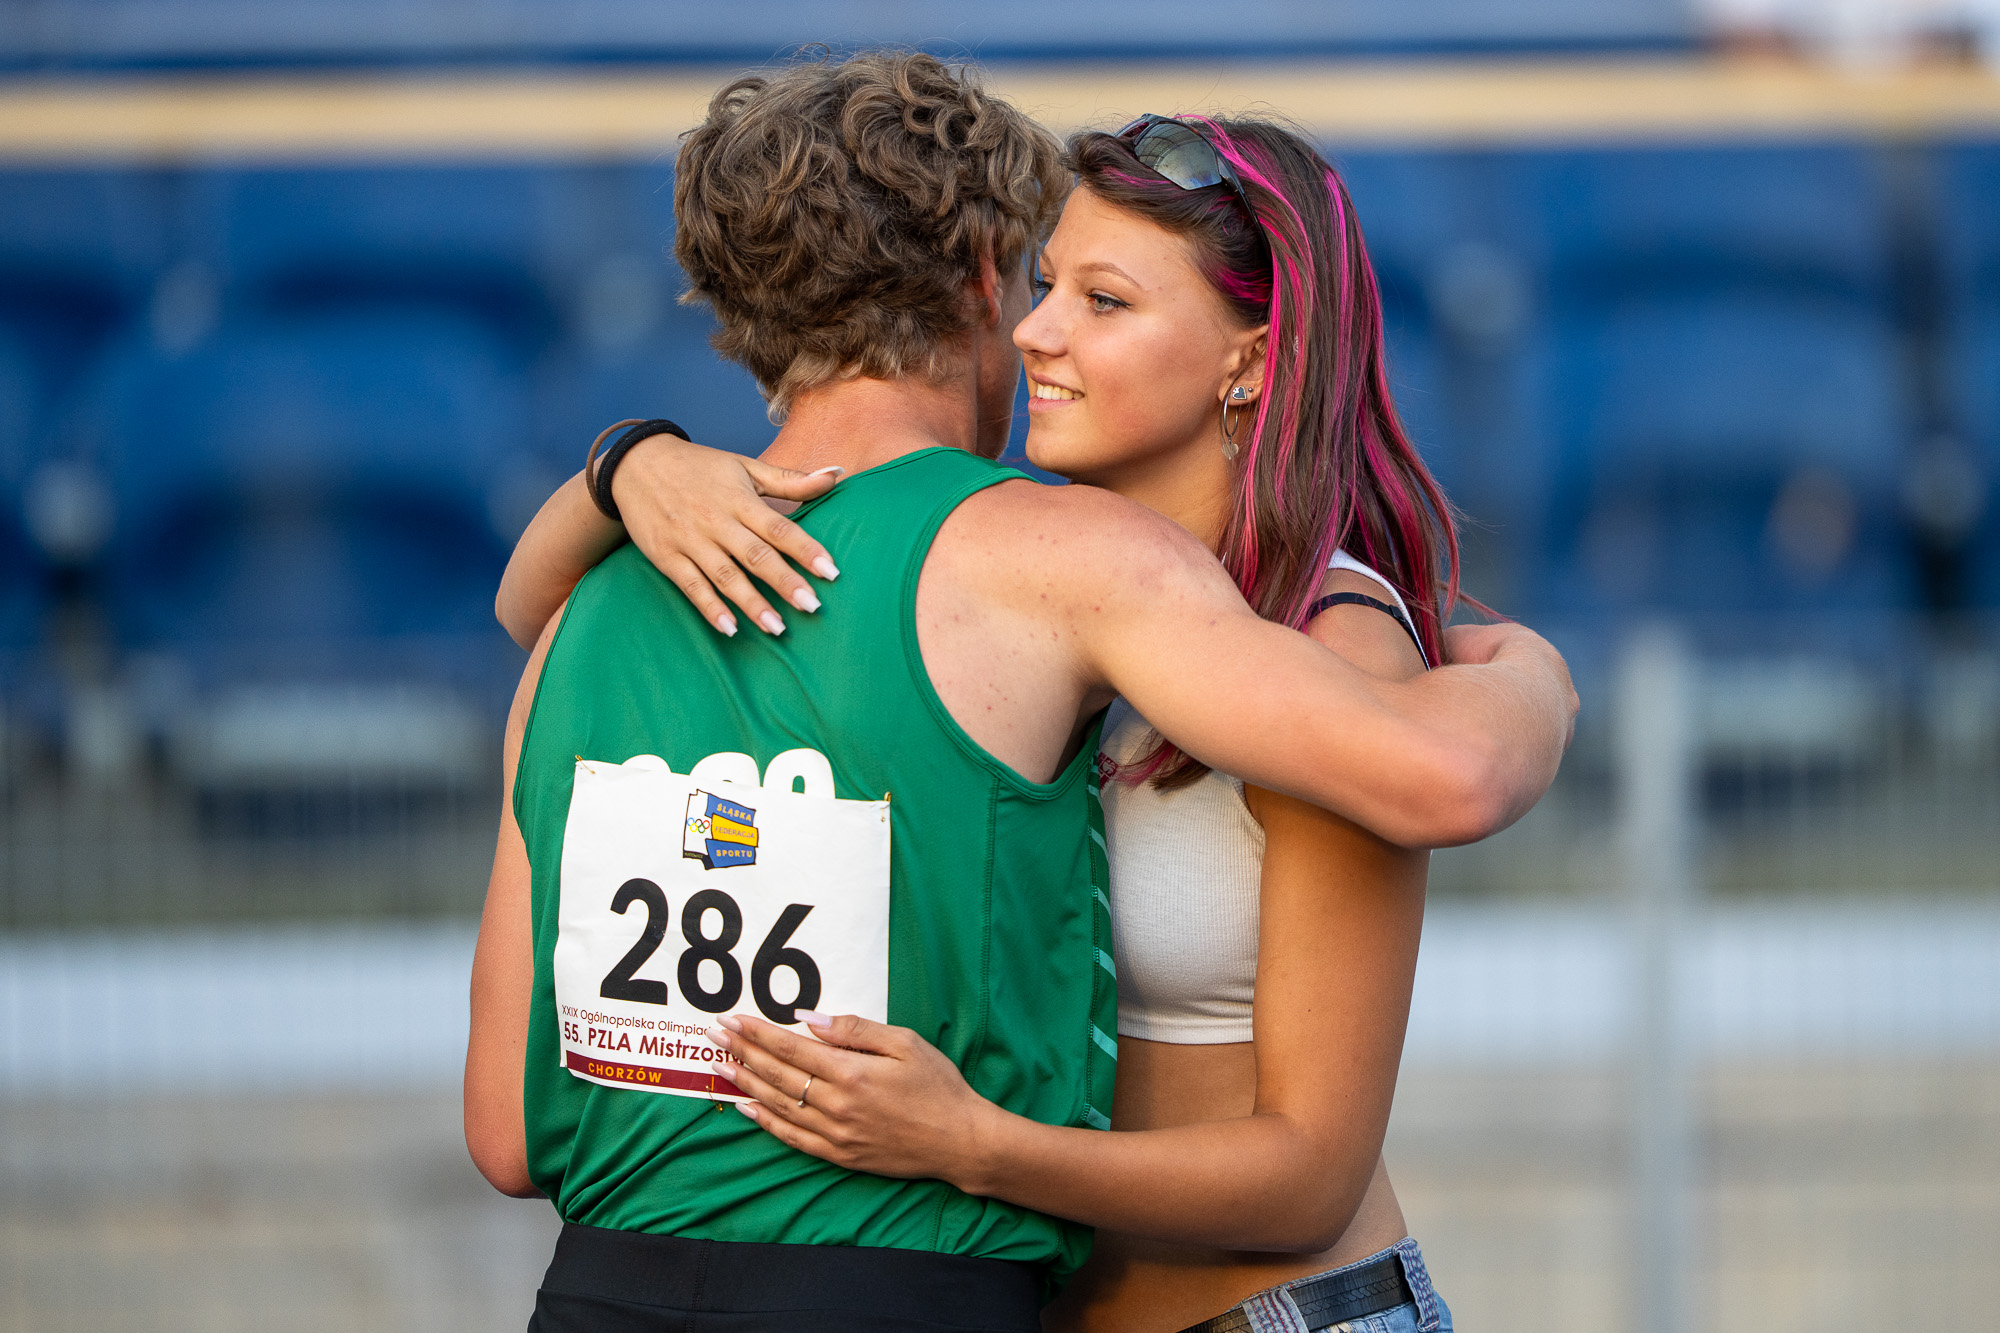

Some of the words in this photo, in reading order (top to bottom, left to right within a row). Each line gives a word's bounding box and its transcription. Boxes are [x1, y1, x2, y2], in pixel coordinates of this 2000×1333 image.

[716, 803, 752, 822] ŚLĄSKA
[714, 826, 755, 839] FEDERACJA
[716, 849, 753, 858] SPORTU
[600, 878, 821, 1025] 286
[561, 1004, 579, 1018] XXIX
[580, 1009, 655, 1029] Ogólnopolska
[564, 1021, 583, 1044] 55.
[588, 1027, 632, 1053] PZLA
[588, 1062, 662, 1083] CHORZÓW
